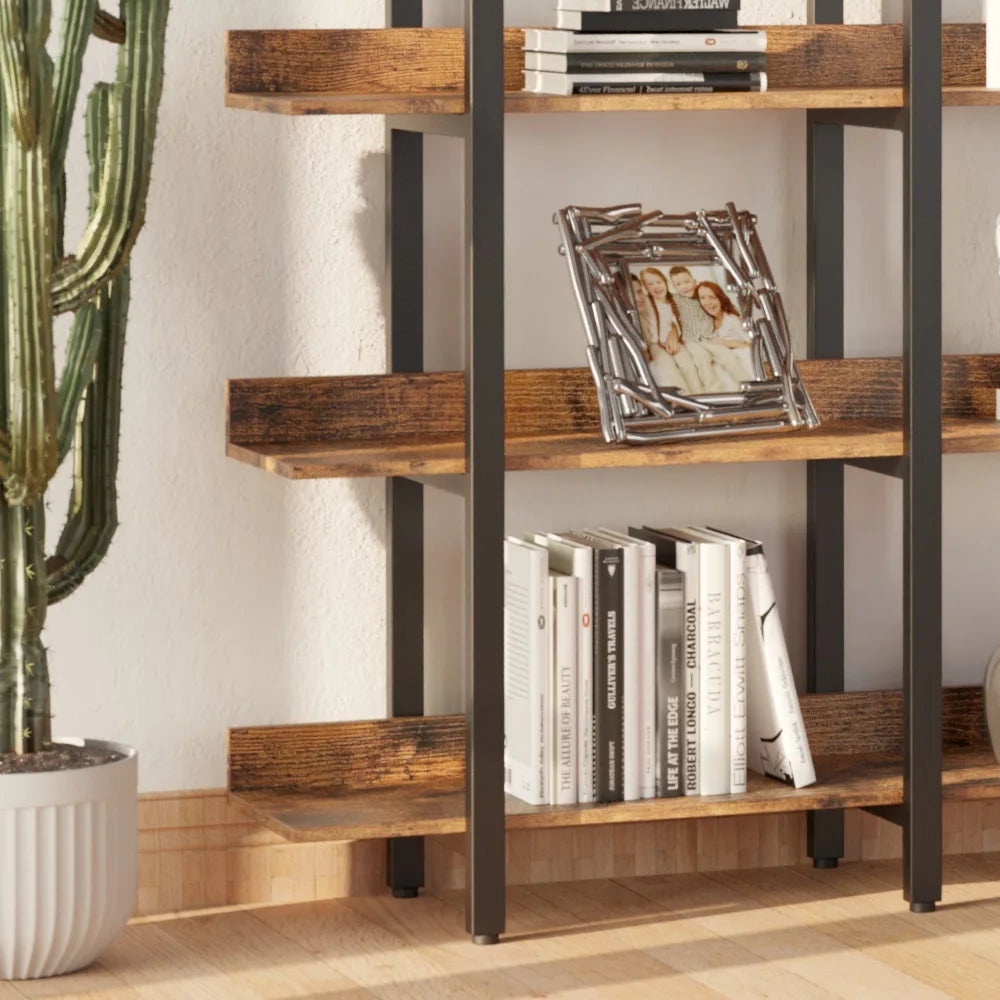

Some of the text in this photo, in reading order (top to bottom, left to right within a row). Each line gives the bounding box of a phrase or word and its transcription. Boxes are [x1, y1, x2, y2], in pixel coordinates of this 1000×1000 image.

[686, 599, 697, 668] CHARCOAL
[734, 572, 746, 646] Snaps
[607, 610, 616, 710] GULLIVER'S TRAVELS
[707, 592, 722, 714] BARRACUDA
[561, 665, 572, 791] THE ALLURE OF BEAUTY
[667, 696, 679, 726] EDGE
[667, 727, 679, 750] THE
[687, 692, 697, 735] LONGO
[667, 752, 679, 765] AT
[667, 768, 679, 790] LIFE
[687, 740, 697, 791] ROBERT
[734, 728, 746, 787] Elliott
